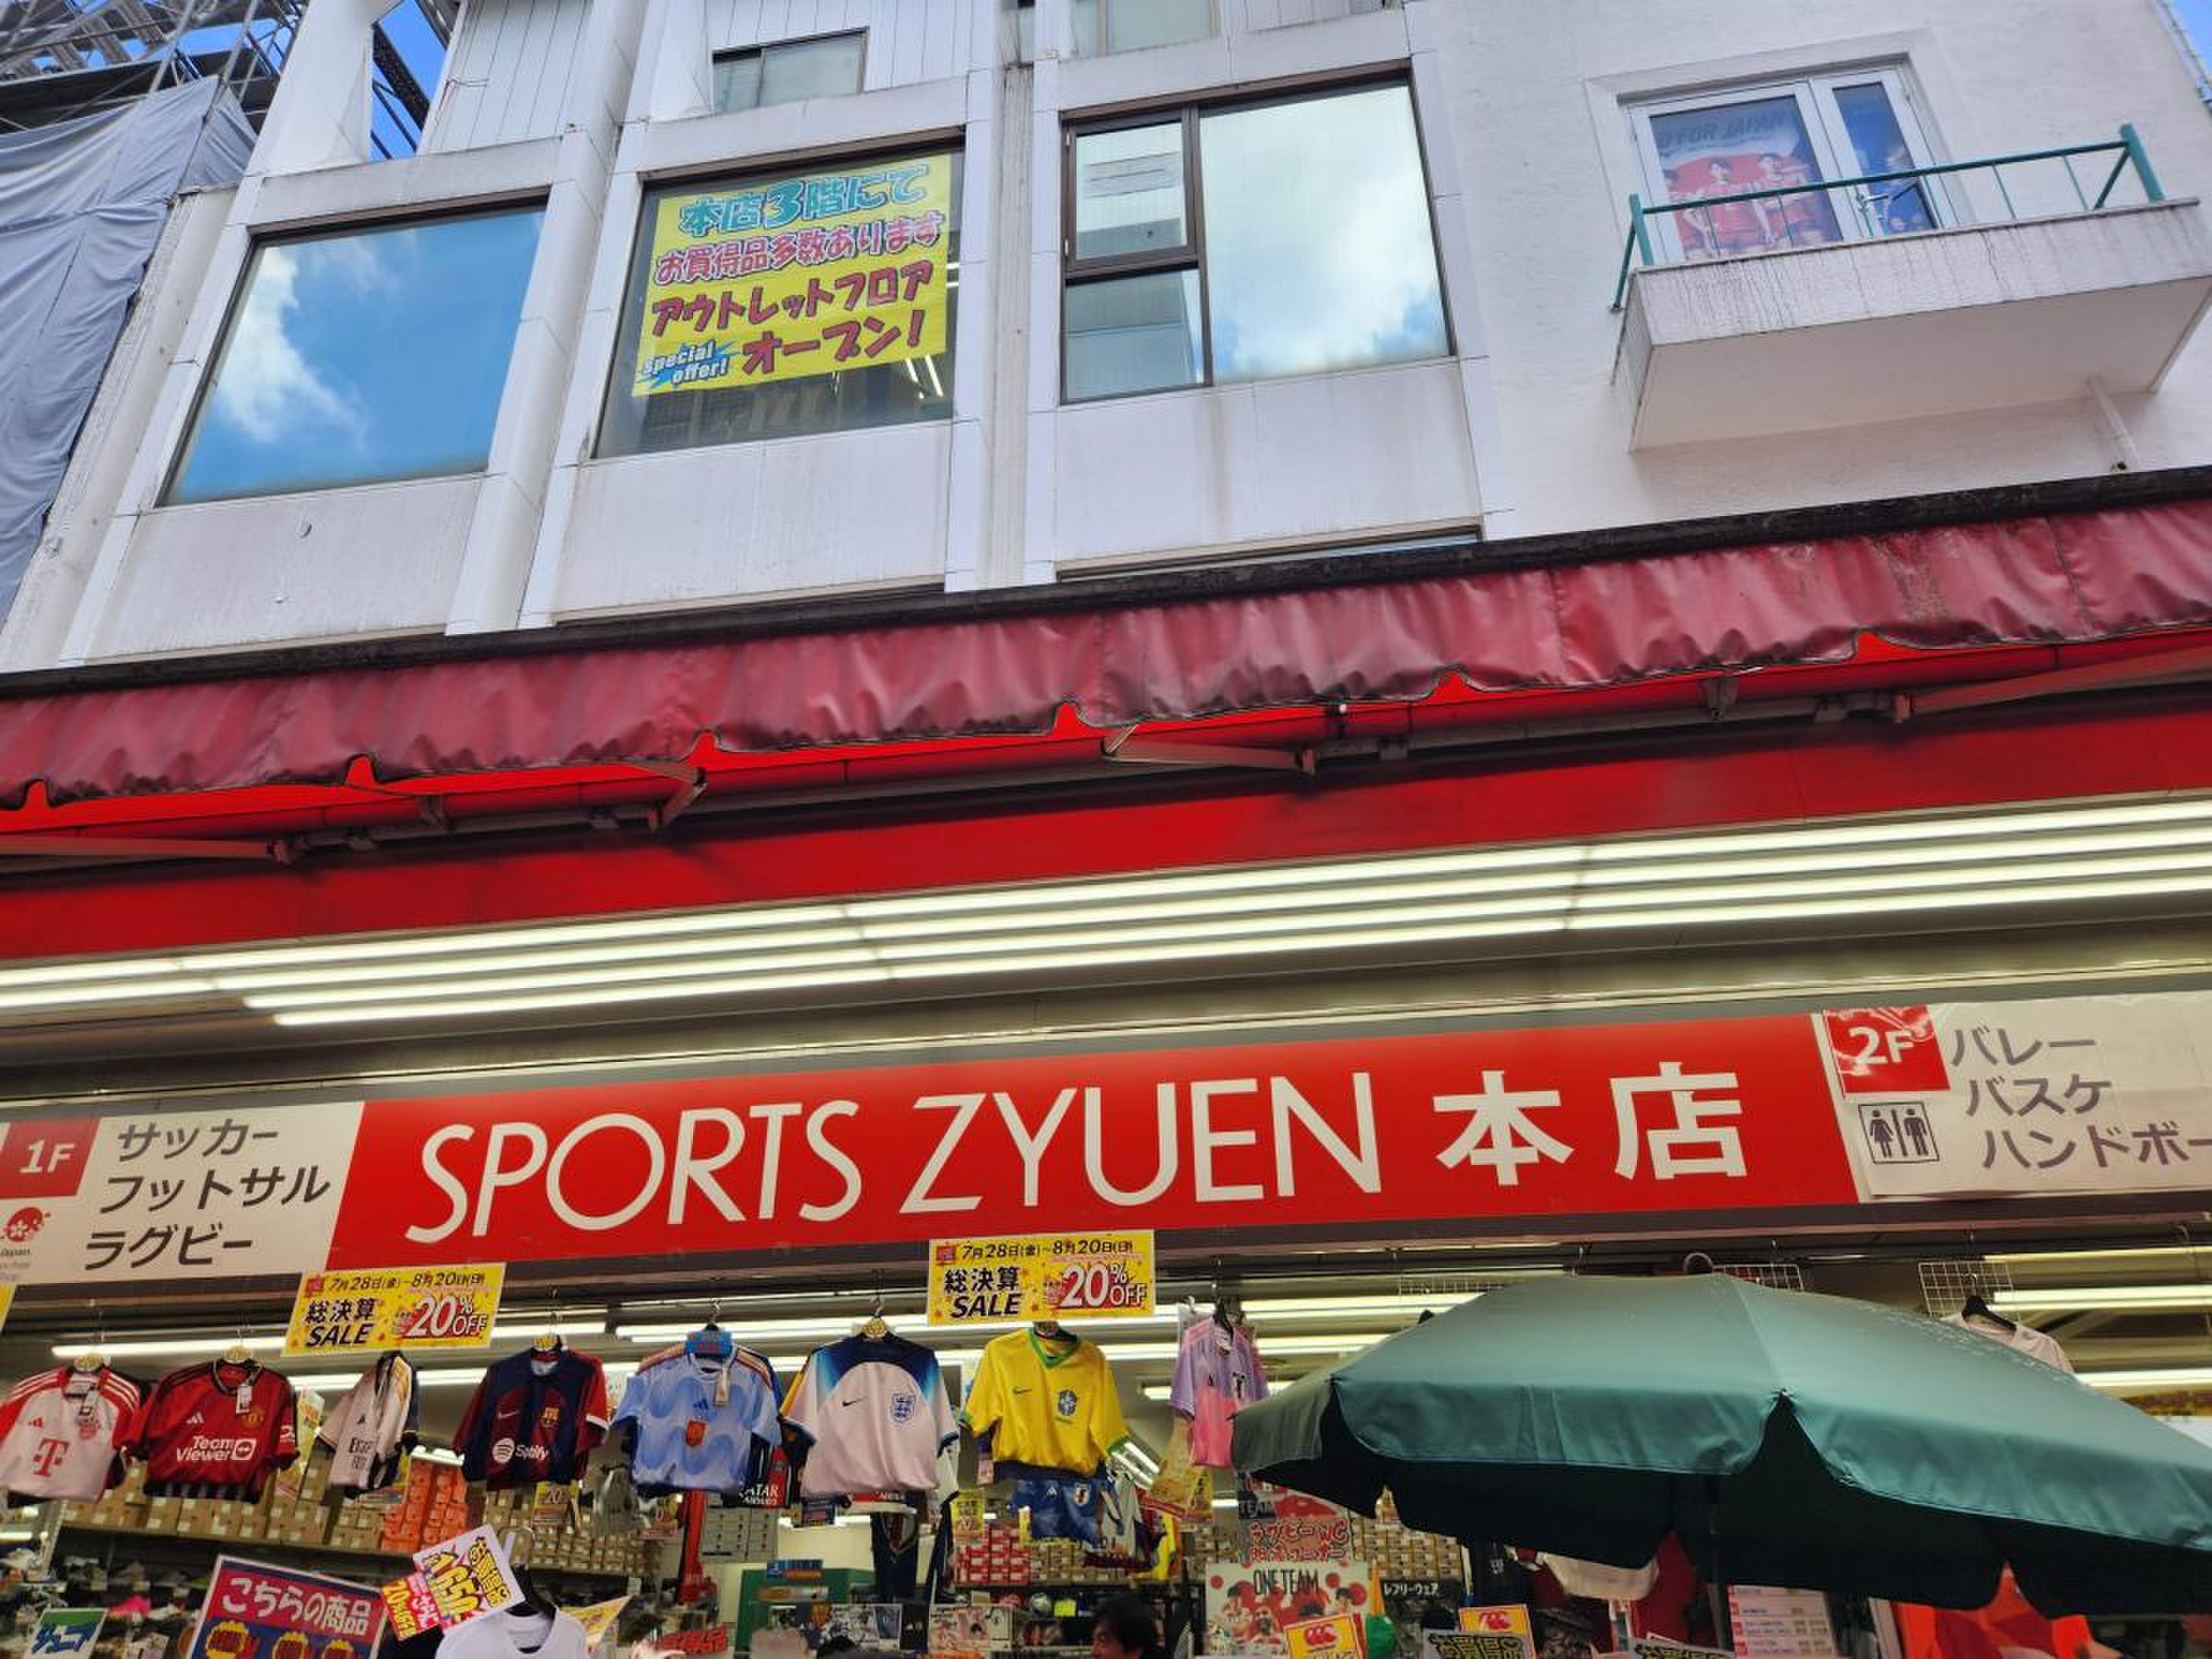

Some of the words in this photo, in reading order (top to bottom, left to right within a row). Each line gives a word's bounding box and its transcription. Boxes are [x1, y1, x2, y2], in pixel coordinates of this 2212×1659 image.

[679, 165, 929, 237] 本店3階にて
[654, 211, 944, 286] お買得品多数あります
[652, 260, 934, 337] アウトレットフロア
[1848, 1025, 1914, 1066] 2F
[1950, 1024, 2097, 1067] バレー
[1965, 1074, 2112, 1117] バスケ
[19, 1138, 76, 1175] 1F
[117, 1119, 278, 1163] サッカー
[405, 1100, 863, 1244] SPORTS
[900, 1072, 1382, 1214] ZYUEN
[1432, 1061, 1748, 1185] 本店
[1983, 1120, 2212, 1169] ハンドボー
[100, 1165, 332, 1215] フットサル
[85, 1222, 253, 1271] ラグビー
[944, 1267, 1019, 1292] 総決算
[305, 1298, 376, 1324] 総決算
[950, 1293, 1022, 1319] SALE
[305, 1324, 374, 1347] SALE
[176, 1445, 231, 1461] Viewer
[191, 1434, 232, 1451] Team
[1253, 1569, 1279, 1595] ONE
[1280, 1568, 1320, 1595] TEAM
[221, 1576, 372, 1637] こちらの商品
